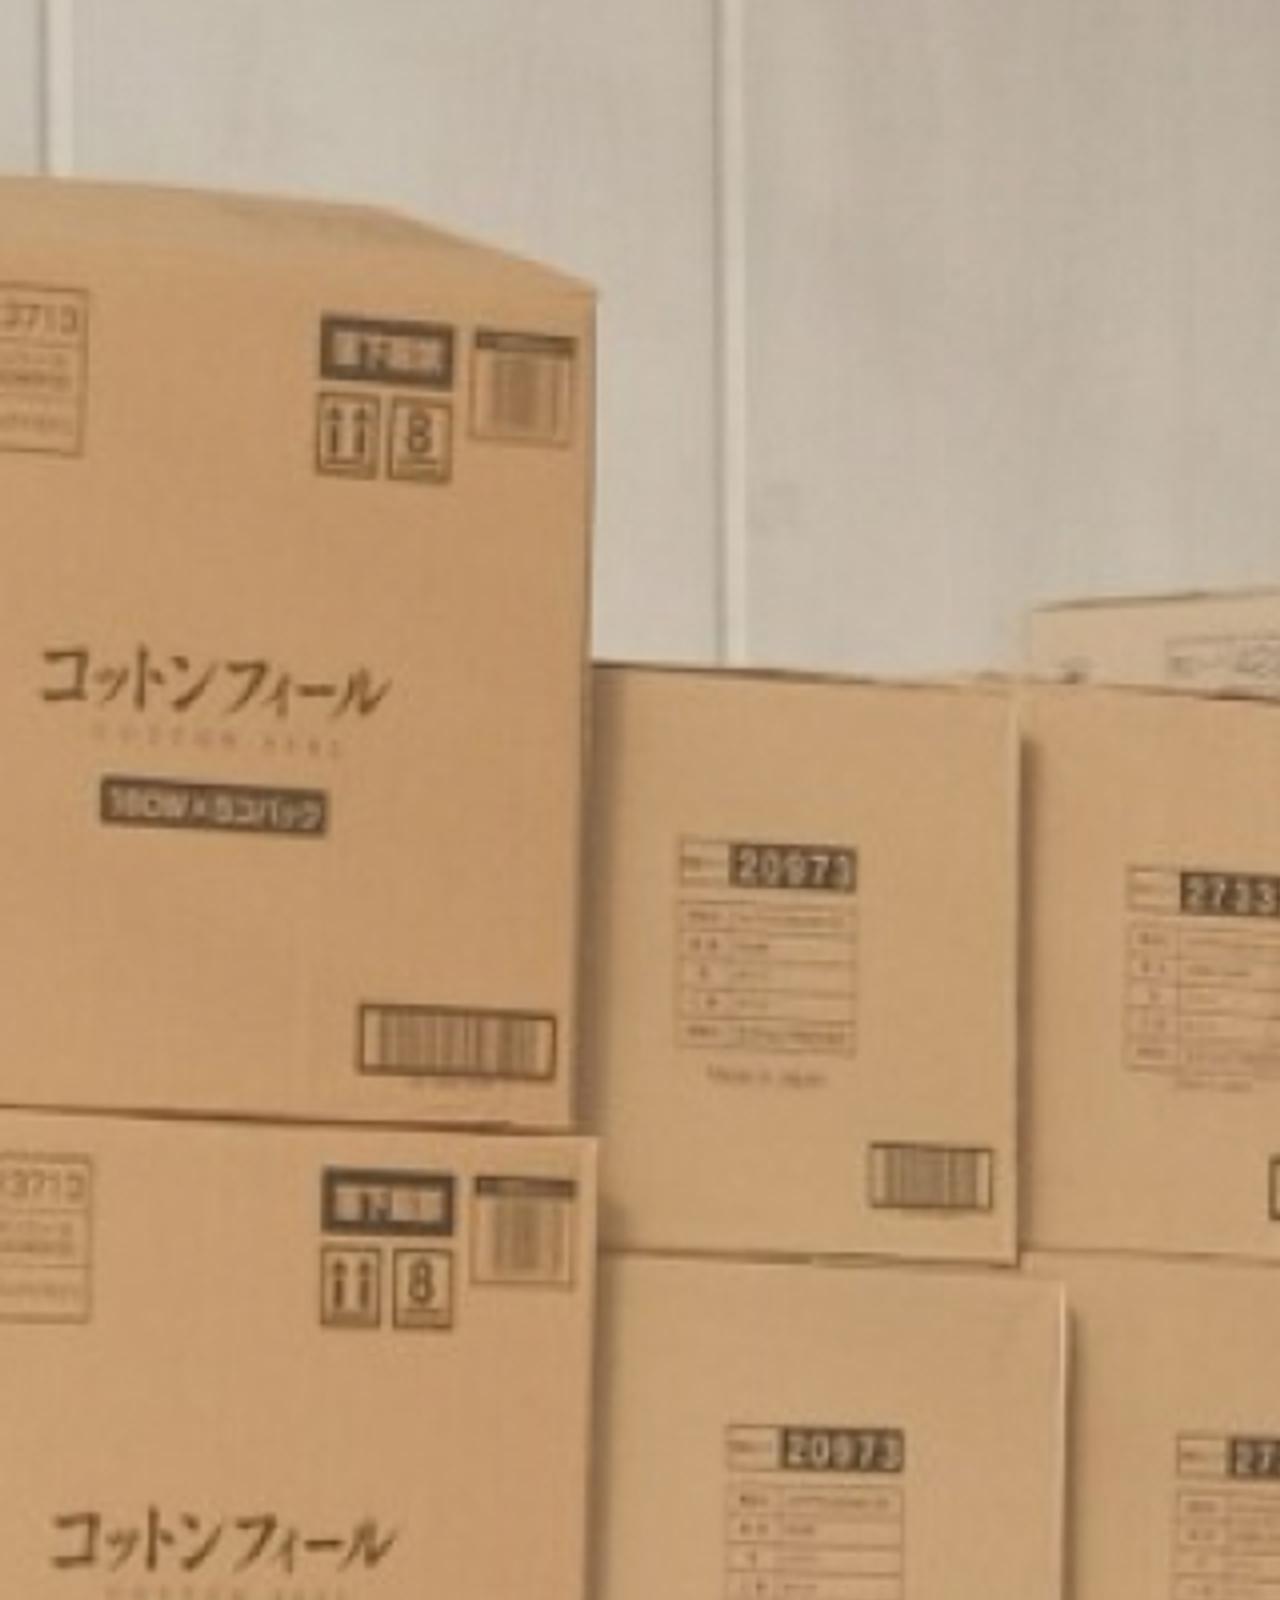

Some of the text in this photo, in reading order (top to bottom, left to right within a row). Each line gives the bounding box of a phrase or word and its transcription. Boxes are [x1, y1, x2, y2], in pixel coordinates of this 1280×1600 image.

[41, 644, 391, 720] コットンフィール
[738, 848, 853, 887] 20973
[785, 1433, 901, 1469] 20973
[50, 1504, 394, 1573] コットンフィール
